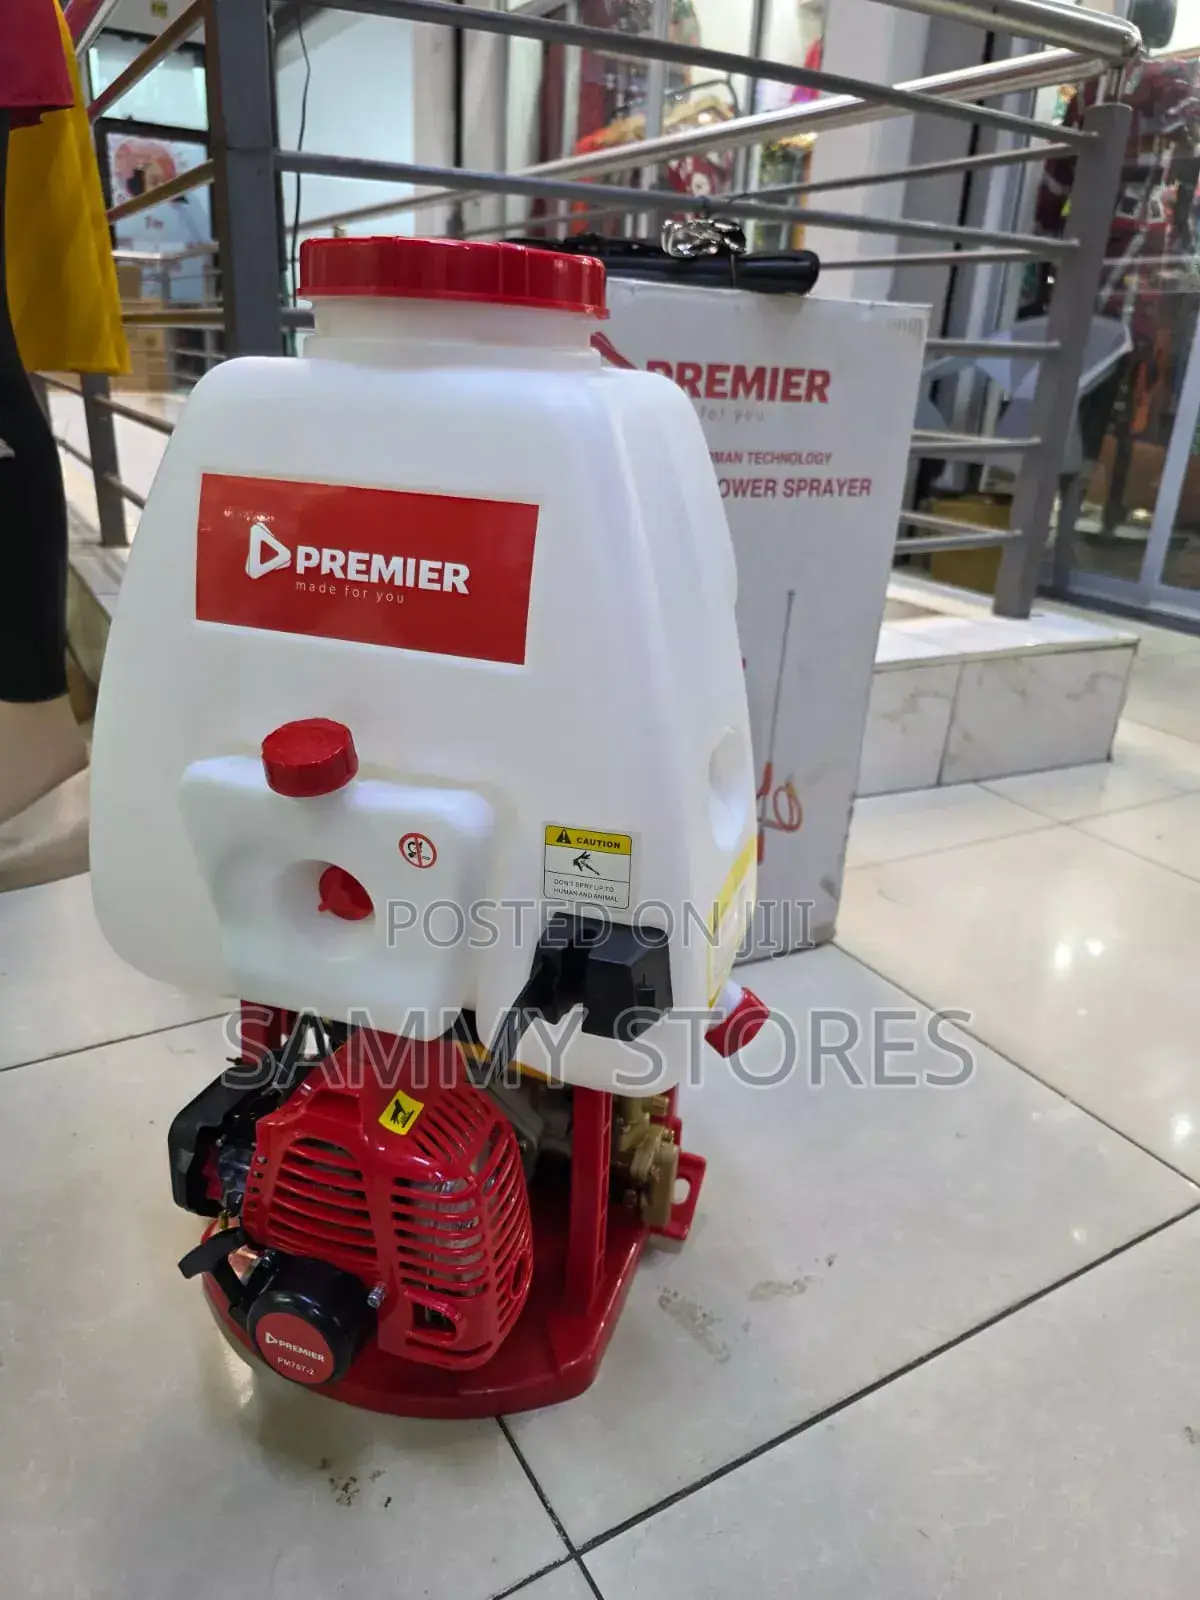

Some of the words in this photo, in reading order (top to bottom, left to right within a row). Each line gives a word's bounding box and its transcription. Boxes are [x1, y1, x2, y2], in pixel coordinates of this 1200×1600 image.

[733, 408, 765, 424] you
[709, 451, 743, 465] MAN
[747, 451, 833, 466] TECHNOLOGY
[718, 478, 776, 499] OWER
[783, 478, 872, 498] SPRAYER
[296, 545, 470, 595] PREMIER
[295, 580, 336, 595] made
[345, 585, 368, 599] for
[376, 590, 405, 605] you
[576, 837, 621, 849] CAUTION
[553, 888, 578, 896] HUMAN
[578, 890, 593, 899] AND
[593, 893, 618, 902] ANIMAL
[279, 1339, 324, 1362] PREMIER
